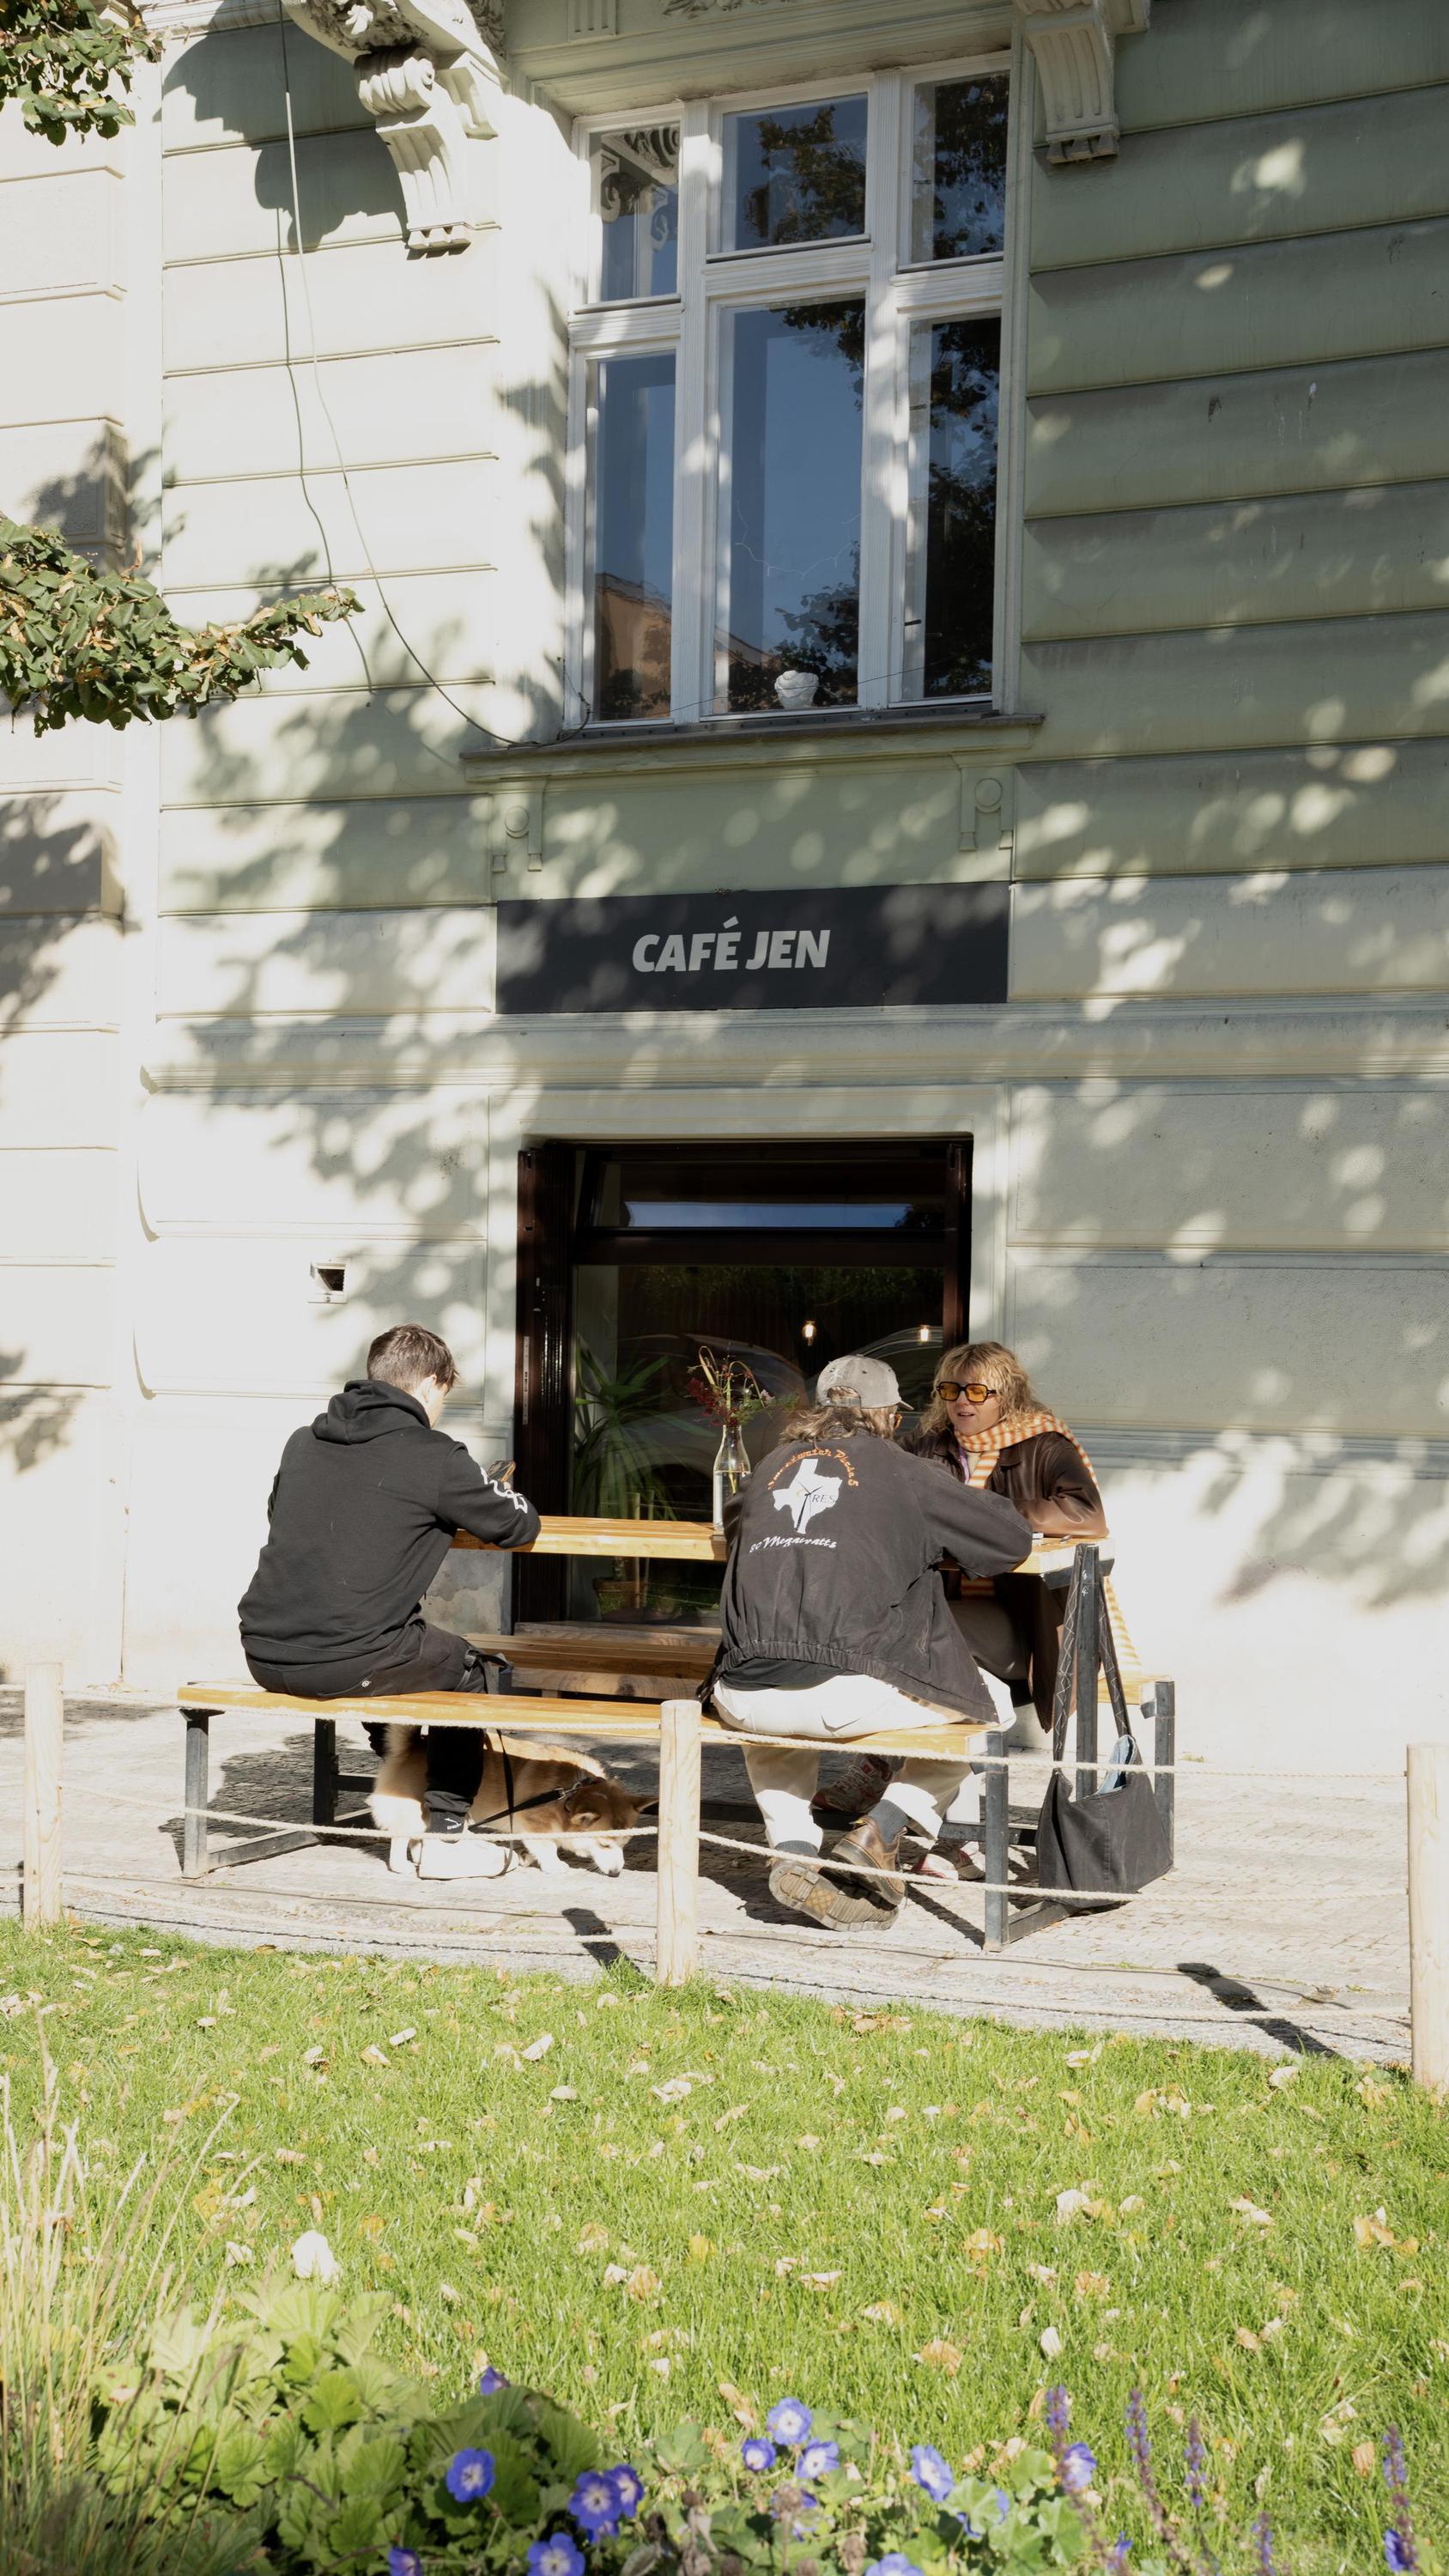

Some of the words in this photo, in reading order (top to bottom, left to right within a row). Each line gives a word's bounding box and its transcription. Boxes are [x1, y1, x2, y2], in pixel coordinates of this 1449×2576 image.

[632, 915, 742, 973] CAFÉ
[745, 929, 831, 970] JEN
[762, 1535, 837, 1549] Megawatts
